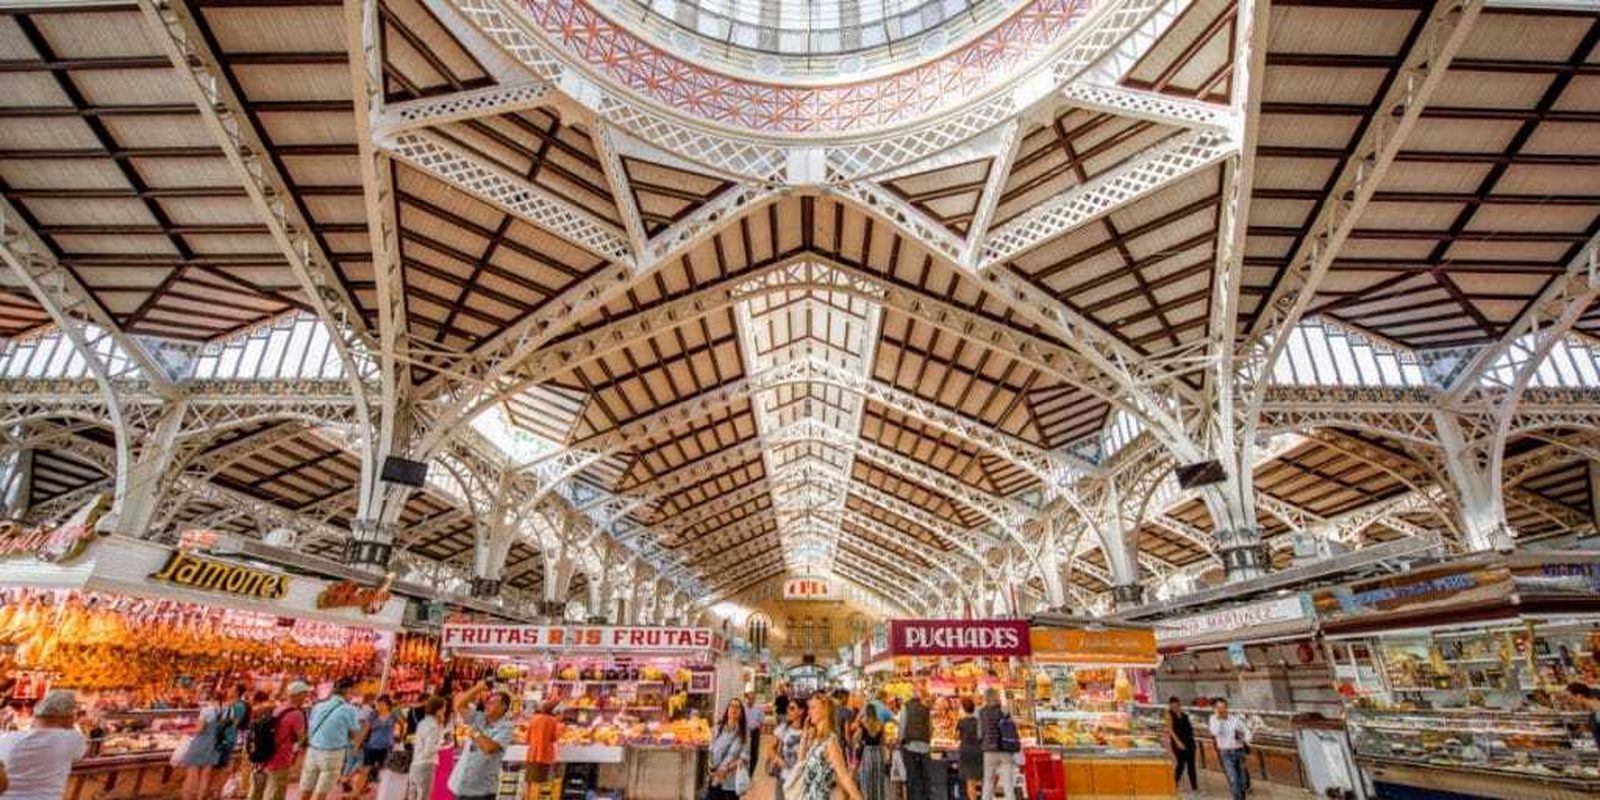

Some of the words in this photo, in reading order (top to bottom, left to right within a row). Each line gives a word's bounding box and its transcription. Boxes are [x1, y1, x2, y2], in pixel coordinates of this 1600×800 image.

[157, 550, 291, 599] Jamones
[445, 627, 538, 645] FRUTAS
[613, 628, 711, 647] FRUTAS
[904, 626, 1020, 649] PUCHADES
